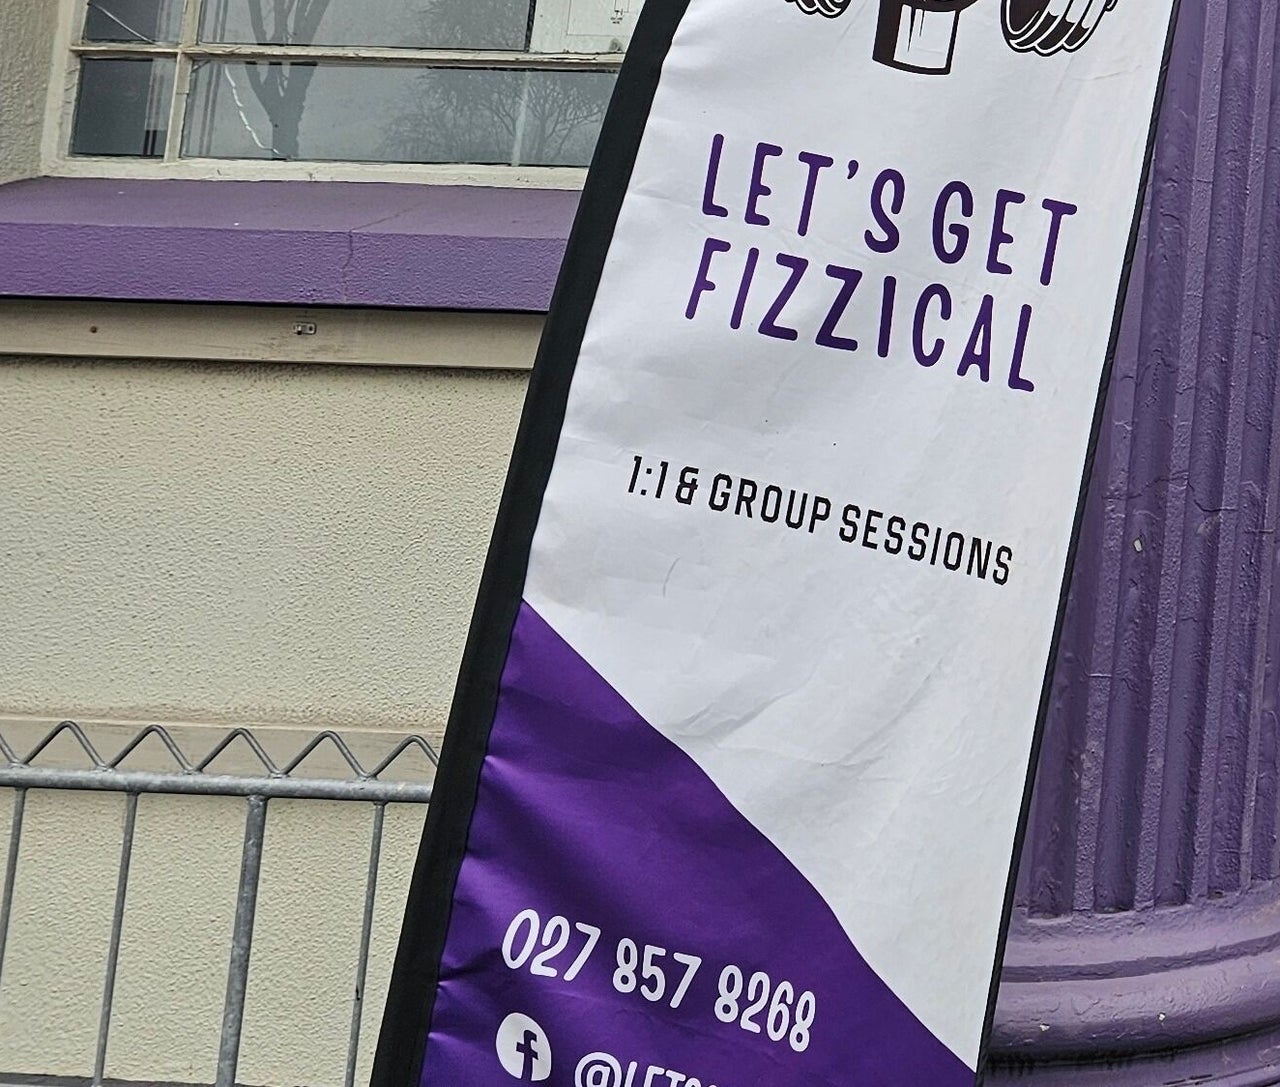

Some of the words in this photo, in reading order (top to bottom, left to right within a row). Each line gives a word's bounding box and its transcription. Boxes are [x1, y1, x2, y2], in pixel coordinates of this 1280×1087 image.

[701, 133, 905, 253] LET'S
[932, 181, 1077, 286] GET
[685, 237, 1034, 392] FIZZICAL
[627, 456, 668, 499] 1:1
[675, 466, 700, 505] &
[709, 473, 831, 533] GROUP
[838, 504, 1013, 585] SESSIONS
[502, 908, 601, 981] 027
[612, 938, 702, 1008] 857
[714, 965, 816, 1052] 8268
